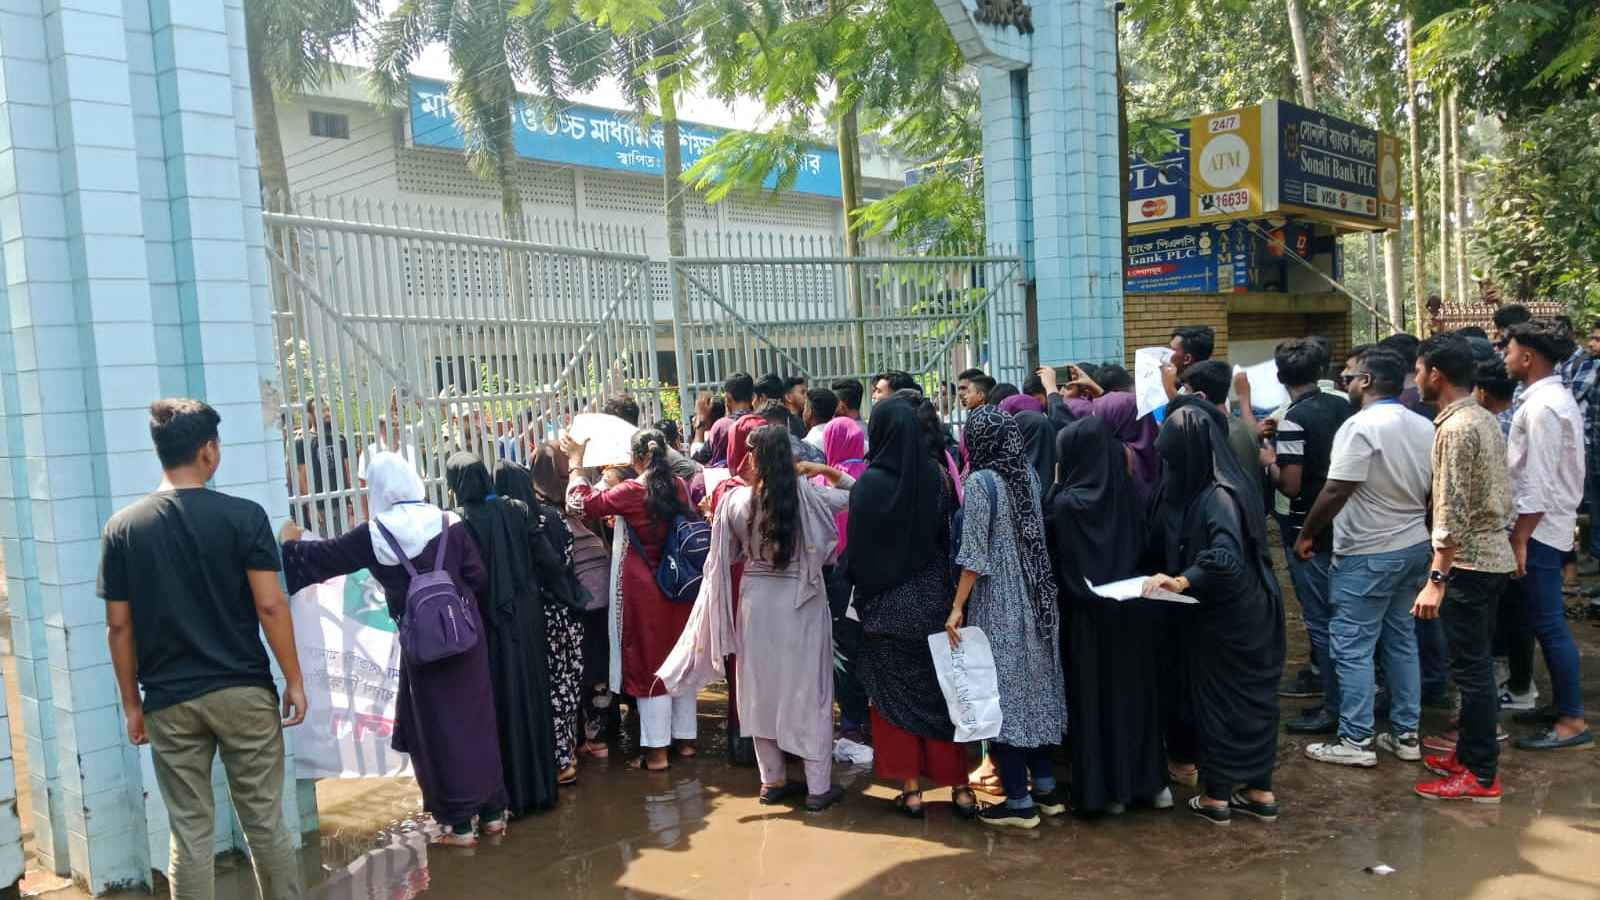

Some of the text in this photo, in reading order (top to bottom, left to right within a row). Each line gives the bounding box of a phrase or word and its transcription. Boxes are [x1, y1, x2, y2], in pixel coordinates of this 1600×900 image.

[1212, 117, 1236, 132] 24/7
[1209, 148, 1242, 171] ATM
[1300, 150, 1331, 177] Sonali
[1332, 157, 1357, 183] Bank
[1357, 163, 1377, 189] PLC
[1216, 190, 1249, 207] 16639
[1167, 249, 1197, 261] PLC
